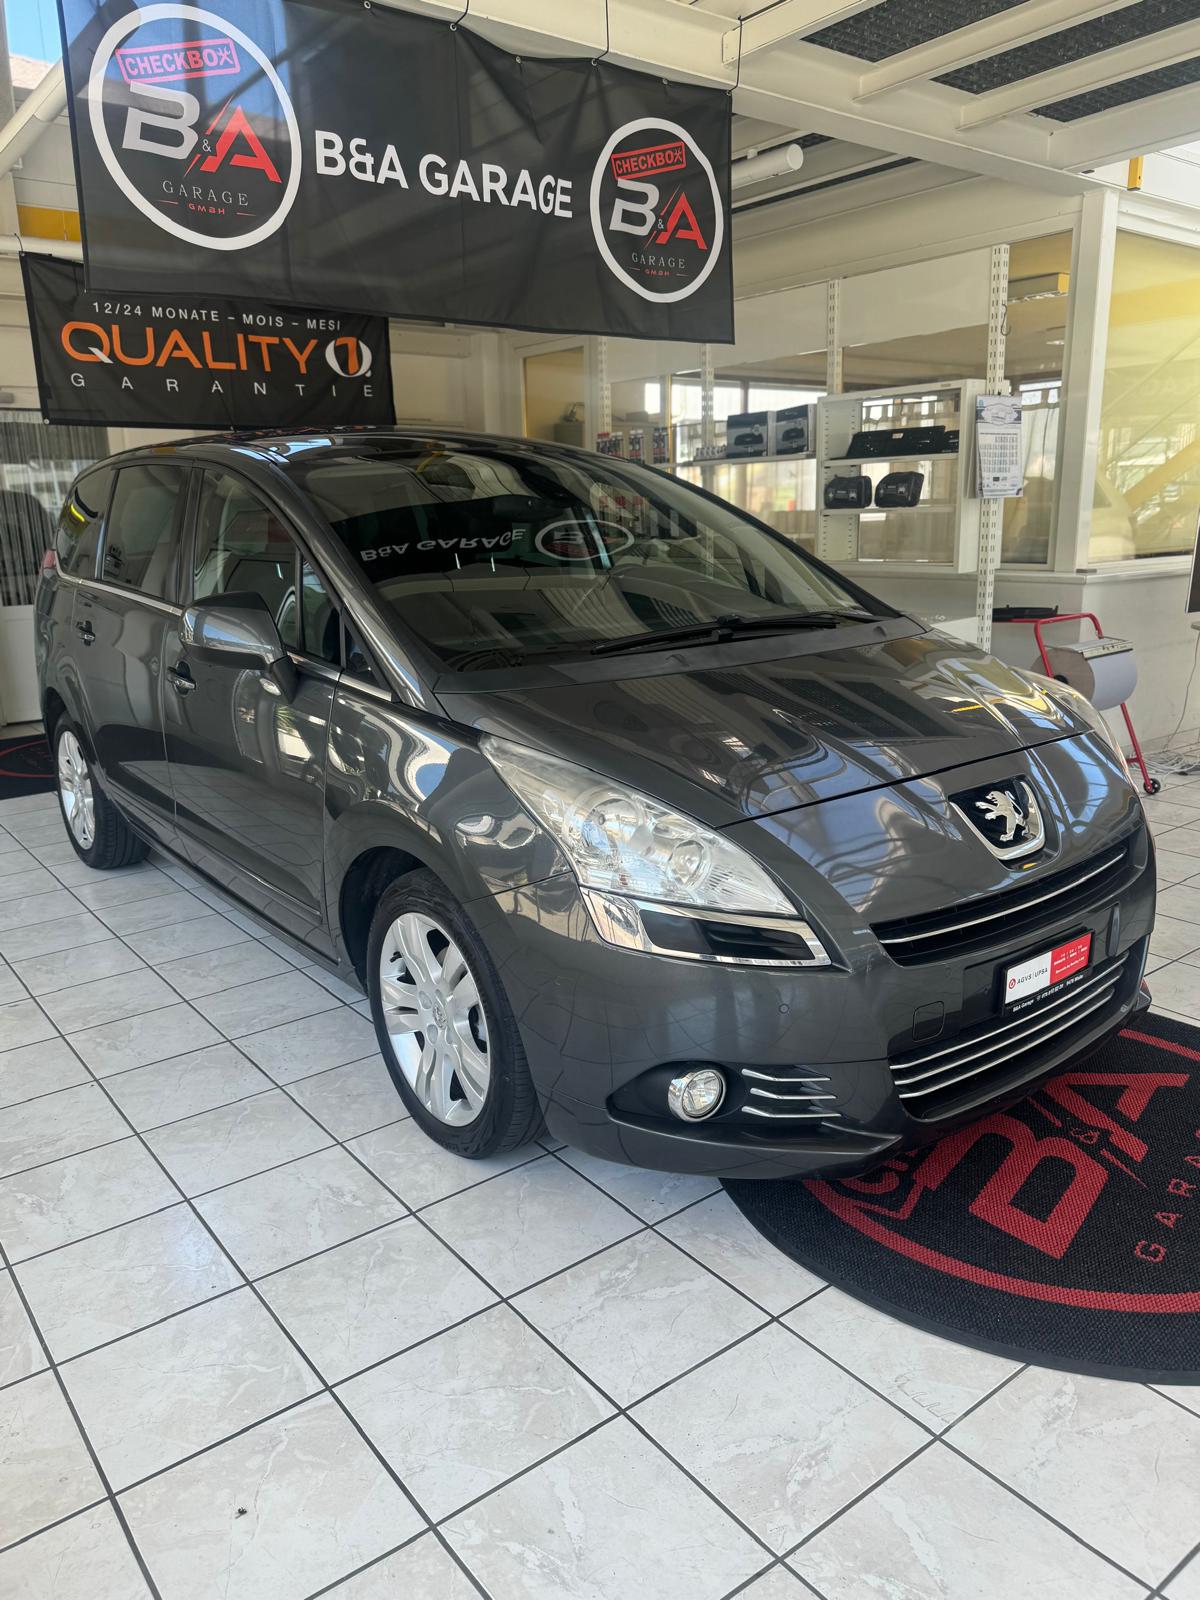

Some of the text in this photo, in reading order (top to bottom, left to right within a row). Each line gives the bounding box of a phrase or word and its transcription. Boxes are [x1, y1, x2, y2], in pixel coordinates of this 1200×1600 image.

[124, 46, 234, 76] CHECKBOX
[314, 129, 573, 219] B&A GARAGE
[614, 147, 683, 175] CHECKBOX
[162, 180, 249, 206] GARAGE
[631, 252, 686, 269] GARAGE
[93, 301, 142, 317] 12/24
[152, 306, 219, 322] MONATE
[242, 313, 284, 328] MOIS
[306, 318, 341, 331] MESI
[61, 320, 318, 375] QUALITY
[70, 372, 374, 398] GARANTIE
